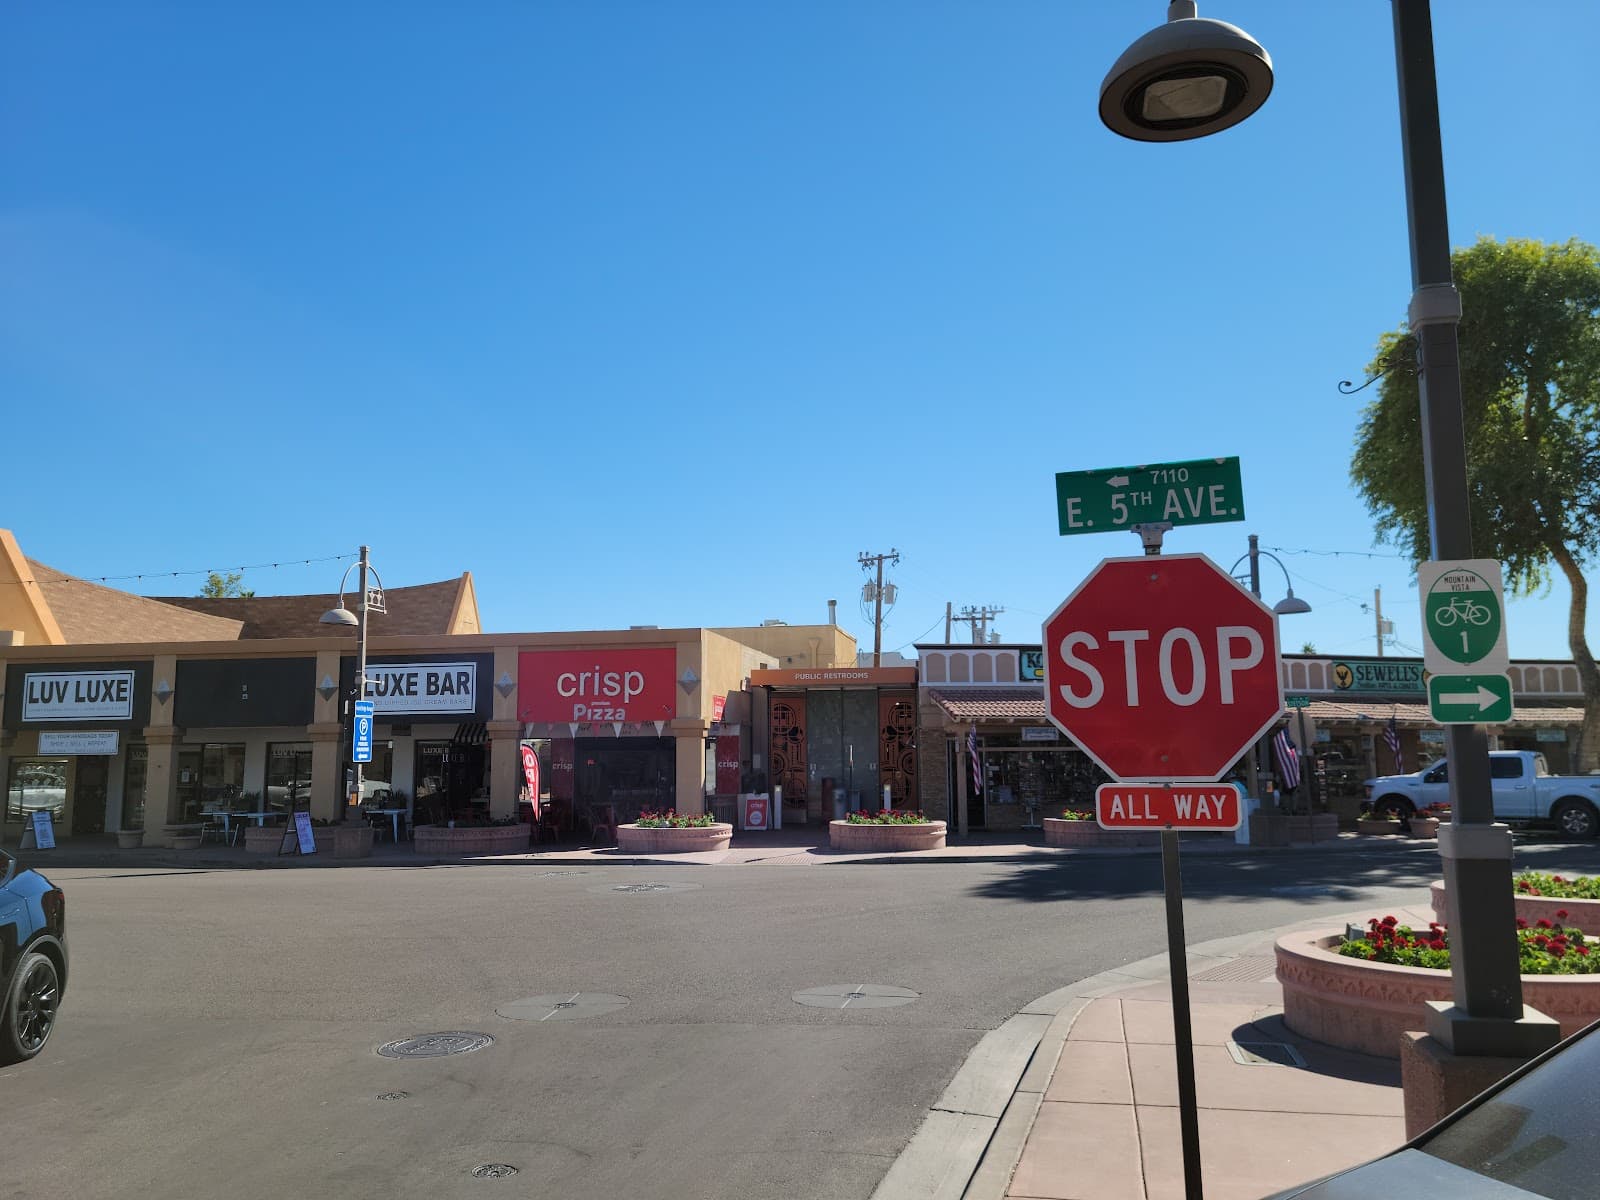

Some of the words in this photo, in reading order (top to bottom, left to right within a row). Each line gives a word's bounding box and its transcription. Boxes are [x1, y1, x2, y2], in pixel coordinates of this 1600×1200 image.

[1150, 468, 1188, 484] 7110
[1066, 497, 1094, 528] E.
[1111, 491, 1152, 524] 5TH
[1163, 485, 1238, 520] AVE.
[1444, 576, 1476, 584] MOUNTAIN
[1460, 630, 1469, 654] 1
[1059, 626, 1264, 708] STOP
[1356, 665, 1420, 682] SEWELL'S
[28, 680, 69, 704] LUV
[74, 680, 128, 703] LUXE
[364, 672, 418, 697] LUXE
[426, 672, 470, 696] BAR
[556, 665, 644, 704] crisp
[574, 704, 626, 721] Pizza
[552, 760, 573, 772] crisp
[718, 758, 738, 770] crisp
[1110, 794, 1158, 820] ALL
[1173, 794, 1227, 820] WAY
